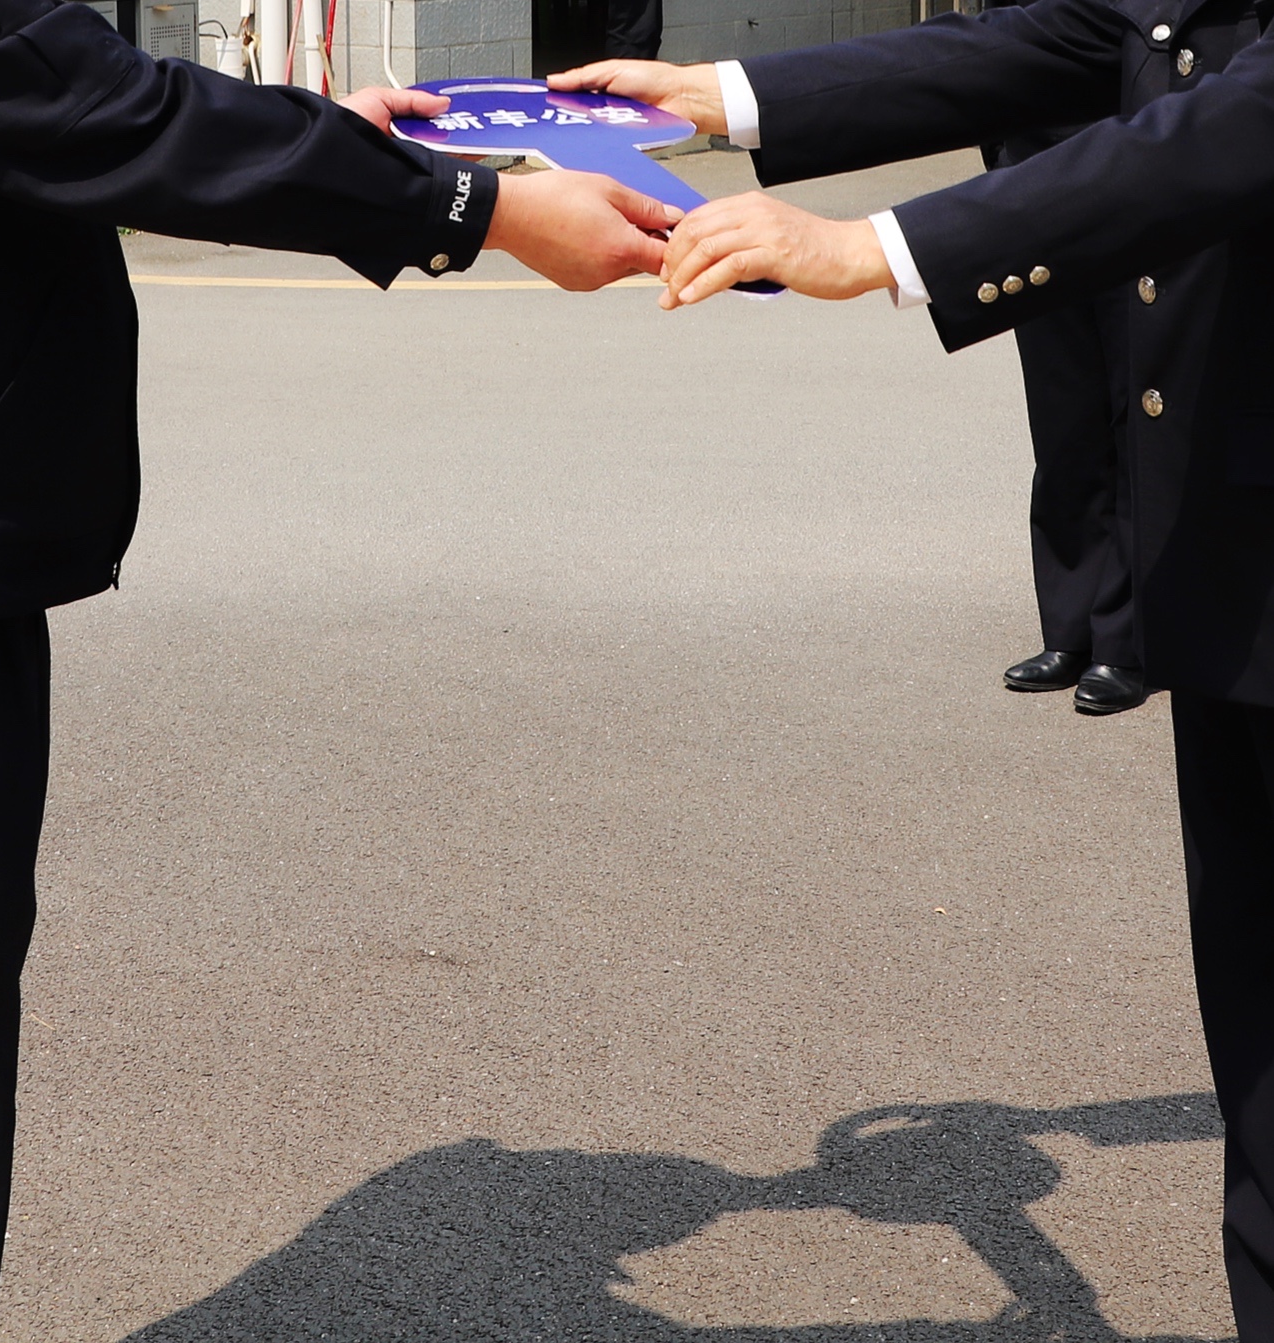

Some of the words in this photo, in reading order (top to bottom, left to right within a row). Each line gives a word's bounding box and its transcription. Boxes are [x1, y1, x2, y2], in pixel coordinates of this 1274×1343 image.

[429, 106, 649, 131] 新丰公安
[449, 170, 472, 223] POLICE
